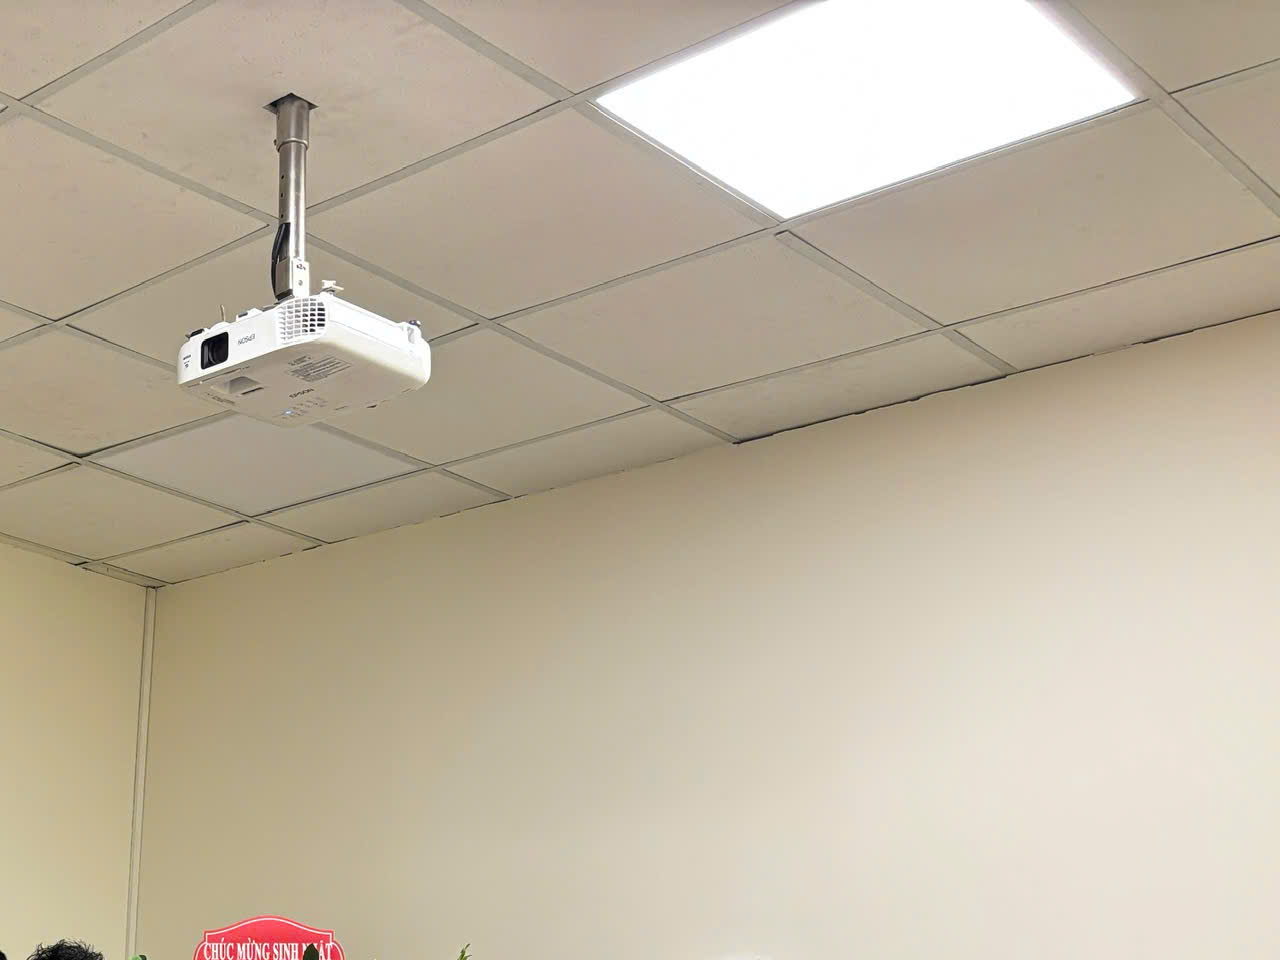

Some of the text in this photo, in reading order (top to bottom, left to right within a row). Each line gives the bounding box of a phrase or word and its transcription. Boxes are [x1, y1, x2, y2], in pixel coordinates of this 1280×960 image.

[203, 938, 234, 960] CHÚC
[236, 938, 270, 960] MỪNG
[272, 942, 299, 960] SINH
